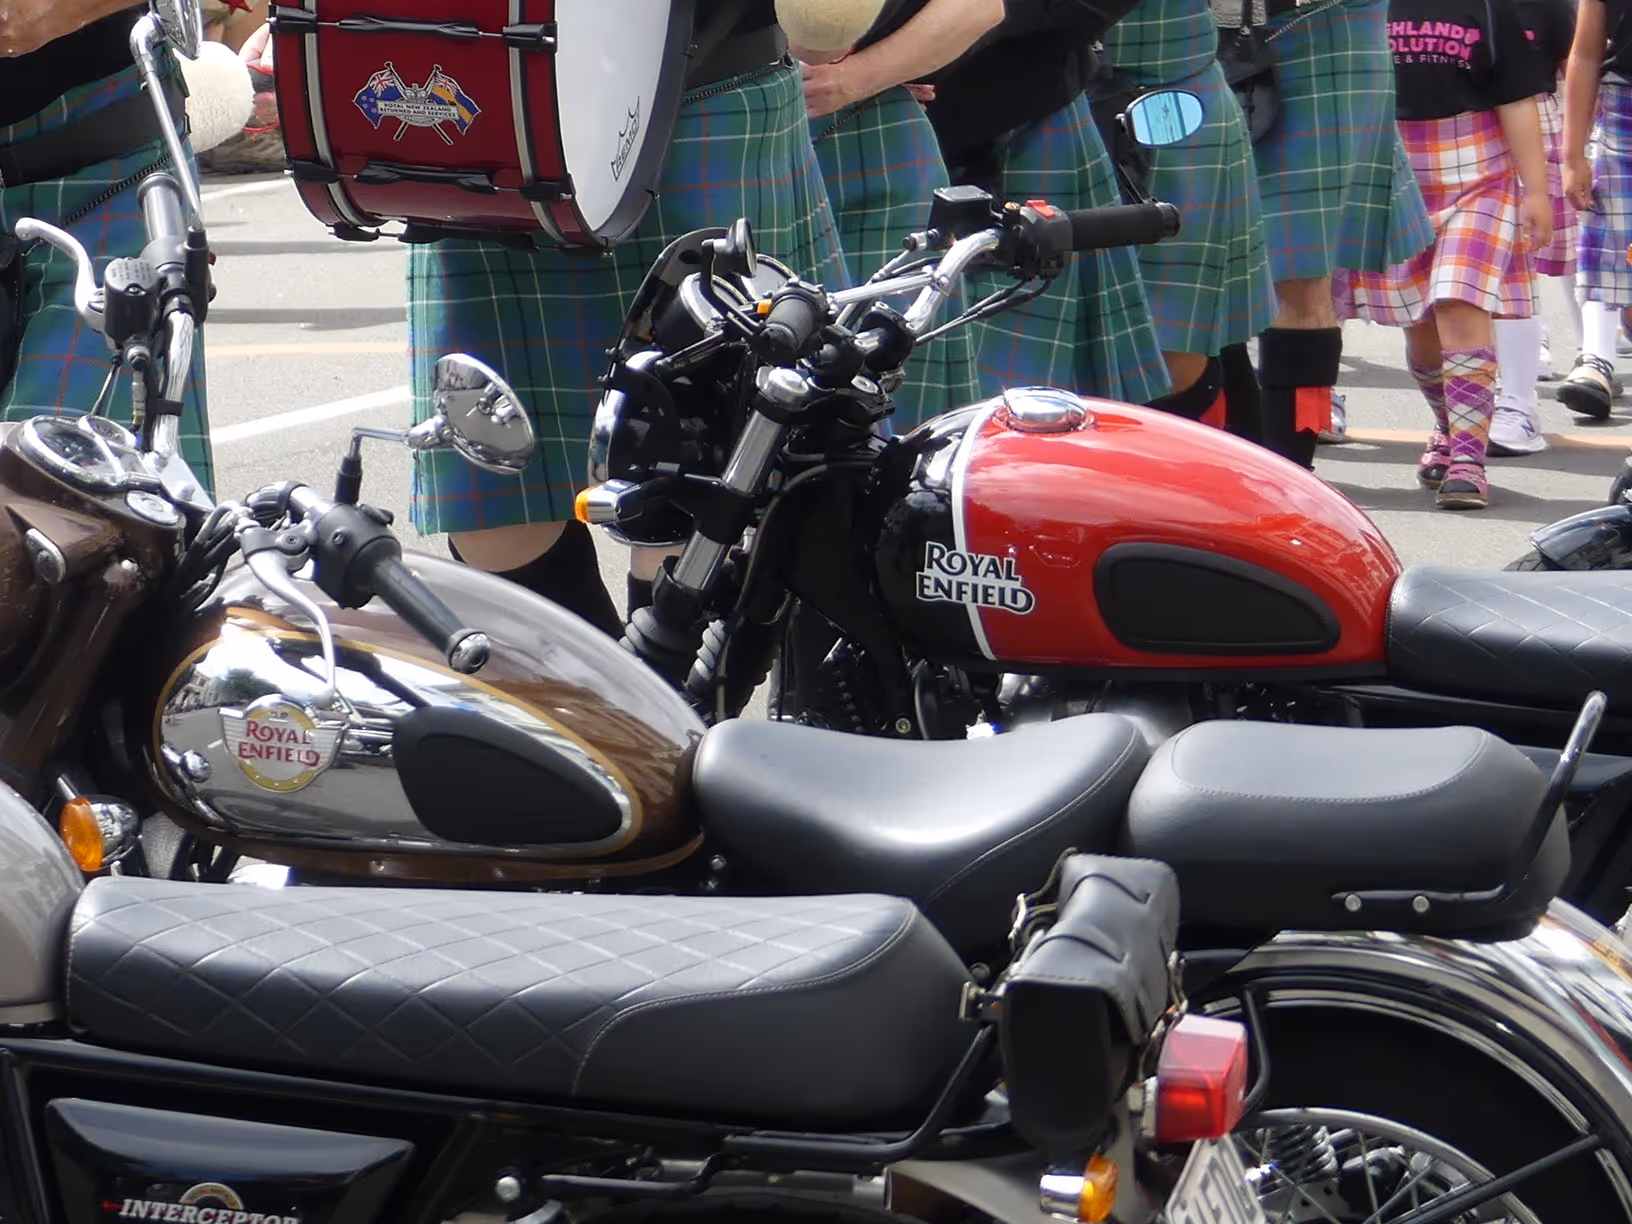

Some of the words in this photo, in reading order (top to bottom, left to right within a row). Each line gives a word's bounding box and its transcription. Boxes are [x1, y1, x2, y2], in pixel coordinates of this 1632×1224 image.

[1386, 21, 1465, 39] HLAND
[1388, 38, 1471, 61] LUTION
[926, 542, 1021, 582] ROYAL
[917, 574, 1033, 613] ENFIELD
[246, 720, 312, 745] ROYAL
[238, 741, 320, 767] ENFIELD
